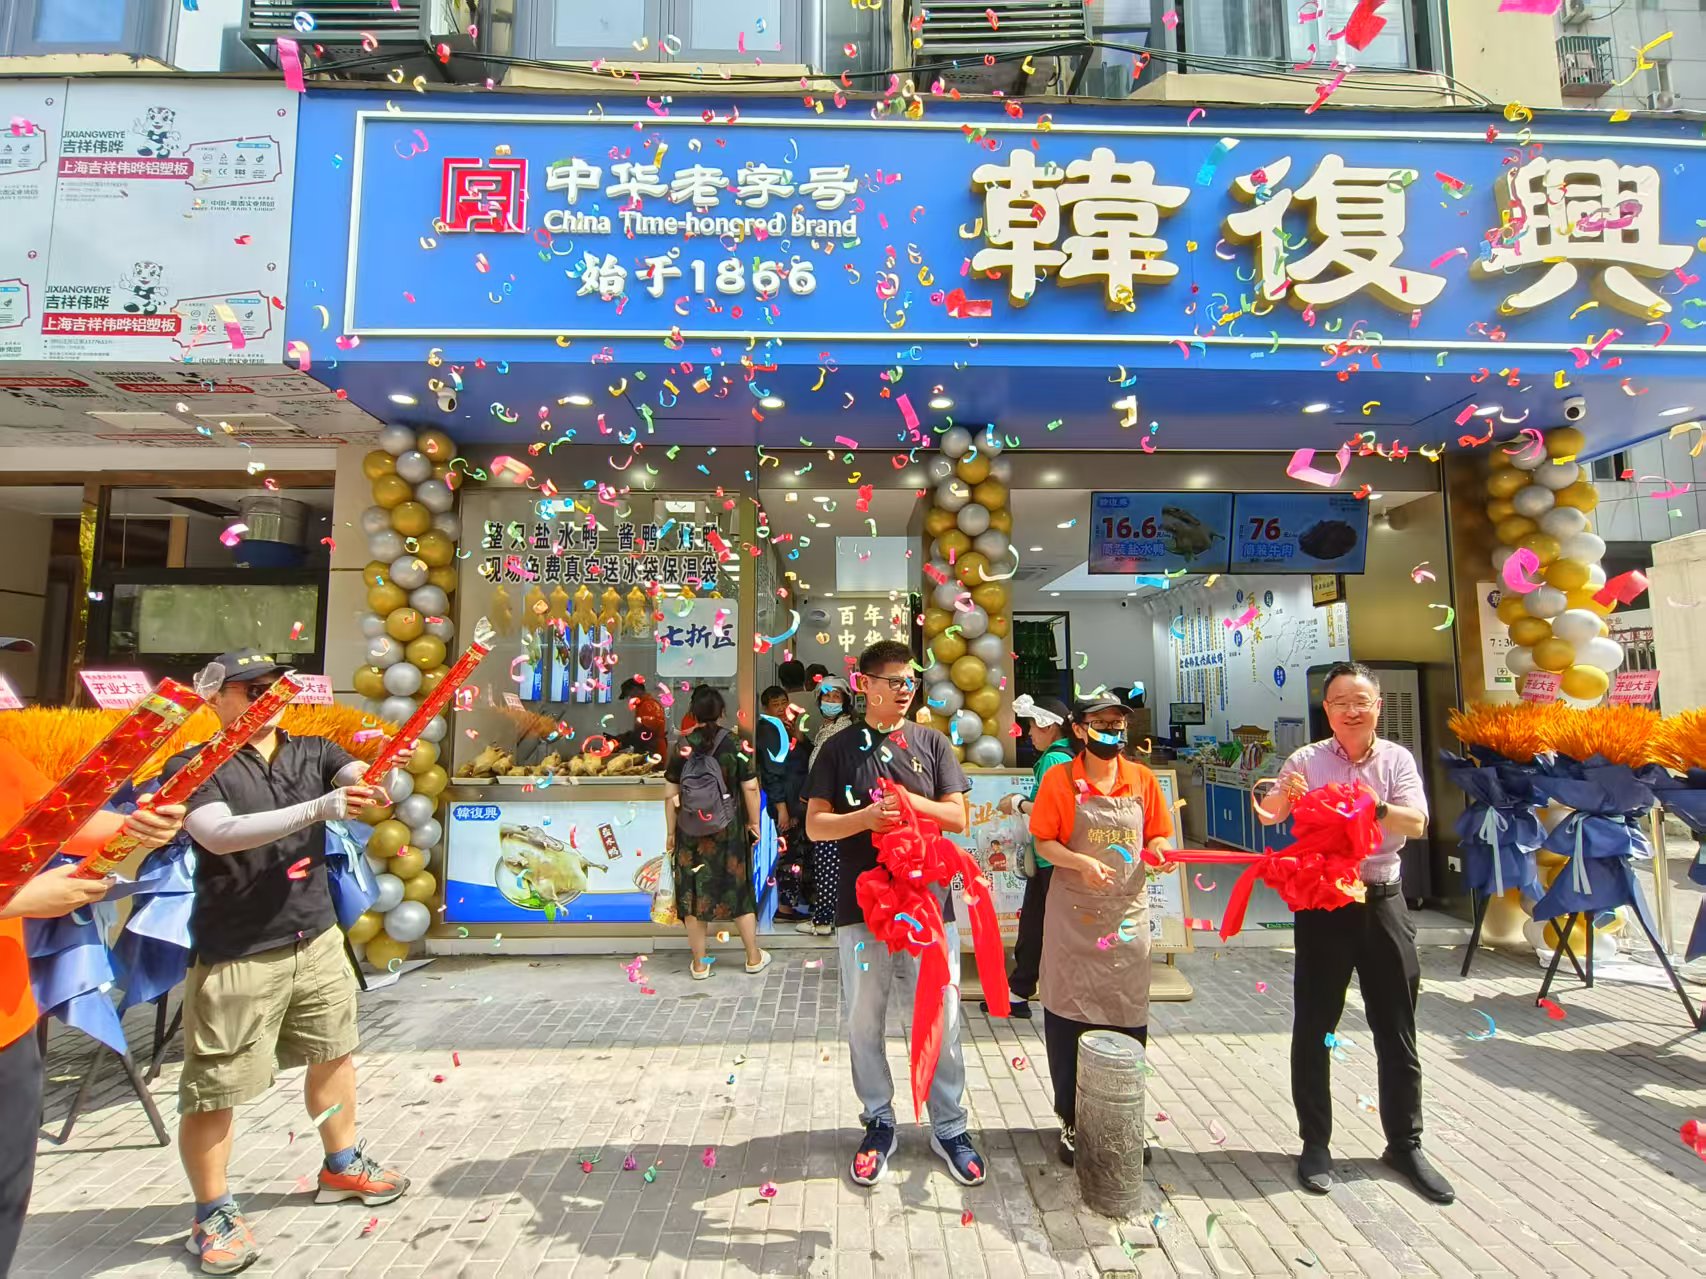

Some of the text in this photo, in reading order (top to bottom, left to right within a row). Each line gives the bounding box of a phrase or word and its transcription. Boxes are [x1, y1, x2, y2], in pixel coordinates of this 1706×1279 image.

[63, 131, 125, 139] JIXIANGWEIYE
[62, 140, 125, 154] 吉祥伟晔
[59, 160, 189, 176] 上海吉祥伟晔铝塑板
[545, 157, 860, 210] 中华老字号
[543, 209, 857, 238] China Time-honored Brand
[970, 147, 1695, 313] 韓復興
[576, 250, 817, 297] 始于1866
[45, 286, 112, 294] JIXIANGWEIYE
[45, 295, 110, 310] 吉祥伟晔
[42, 316, 177, 332] 上海吉祥伟晔铝塑板
[1103, 516, 1157, 539] 16.6
[1249, 517, 1281, 540] 76
[618, 522, 660, 551] 酱鸭
[660, 624, 736, 649] 七折区
[92, 682, 147, 695] 开业大吉
[300, 682, 327, 694] 大吉
[1524, 680, 1556, 692] 开业大吉
[1614, 681, 1653, 692] 开业大吉
[455, 806, 498, 820] 韓復興
[1087, 828, 1137, 844] 韓復興
